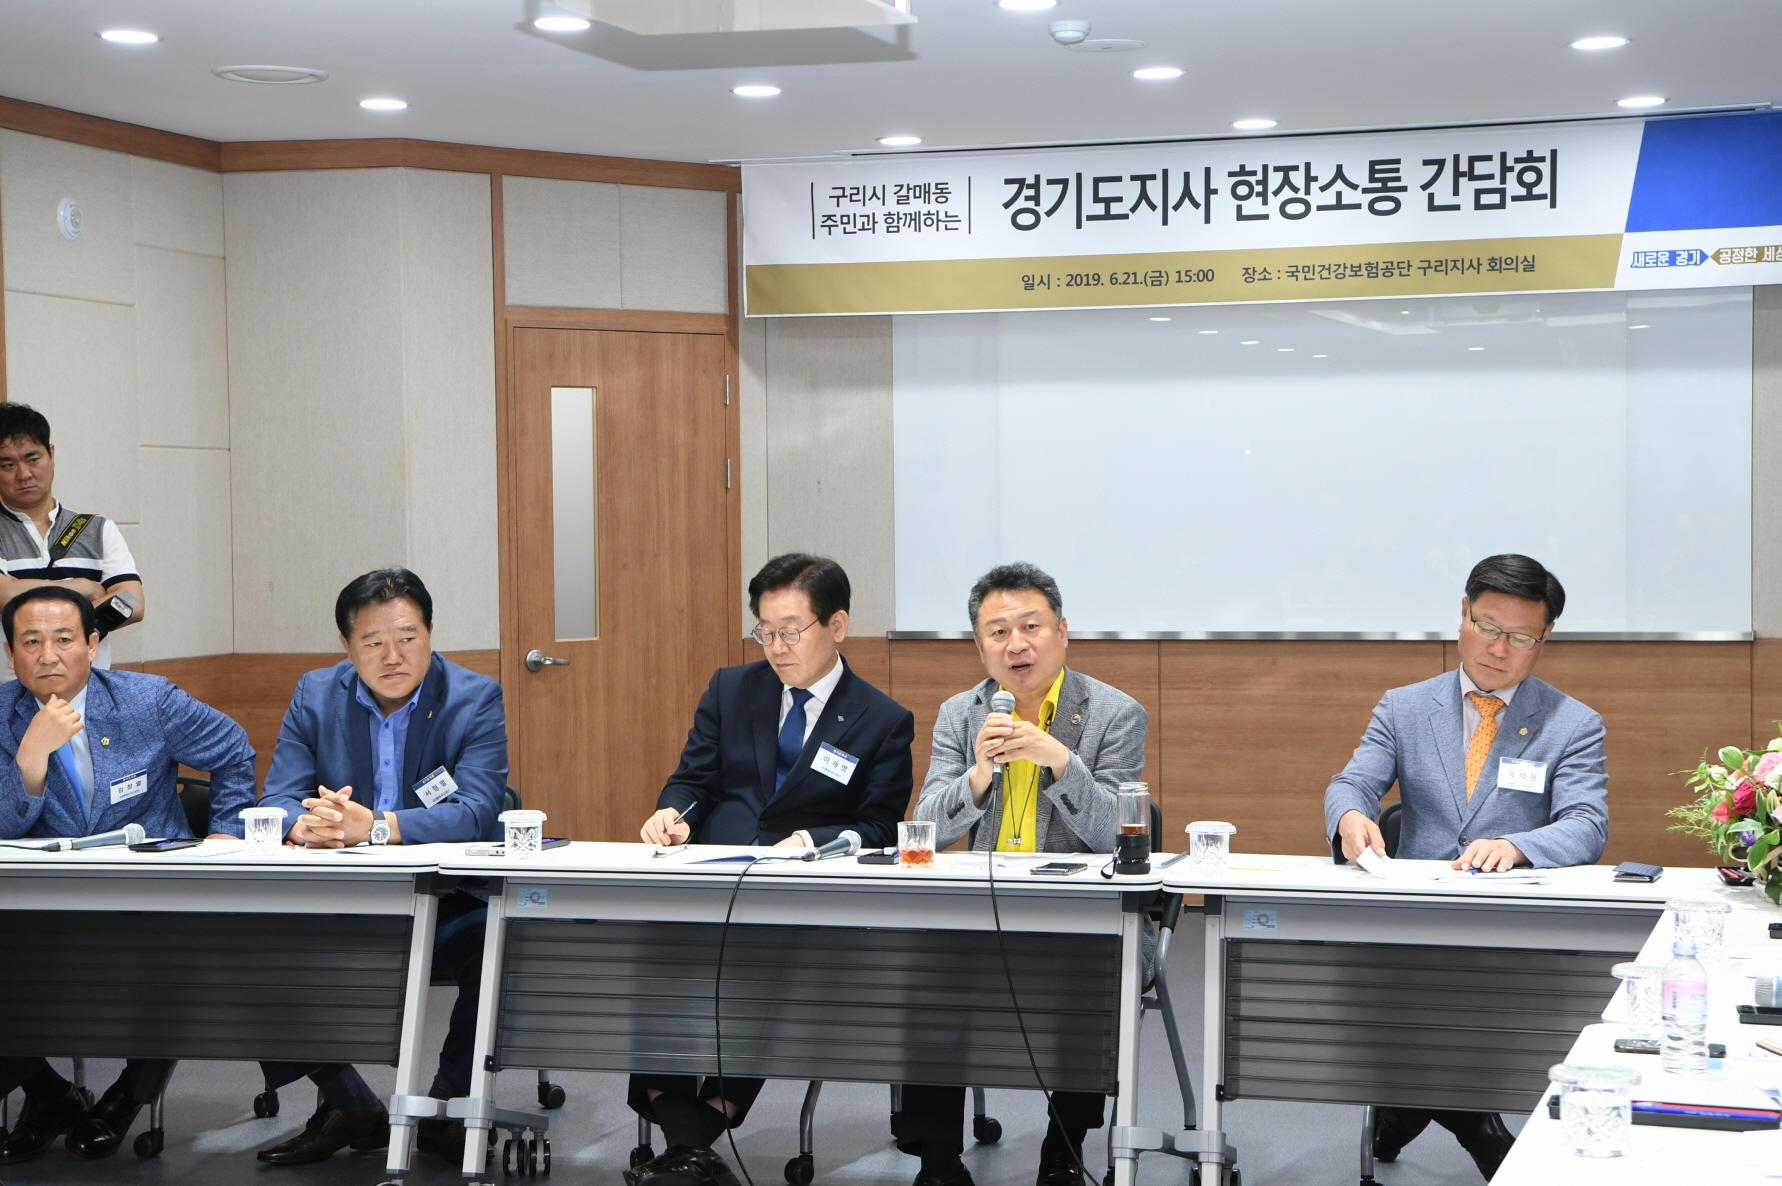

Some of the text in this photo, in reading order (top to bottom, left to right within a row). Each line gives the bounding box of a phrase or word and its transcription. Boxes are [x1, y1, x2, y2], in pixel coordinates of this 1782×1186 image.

[828, 182, 952, 208] 구리시 갈매동
[1001, 148, 1558, 232] 경기도지사 현장소통 간담회
[820, 210, 962, 236] 주민과 함께하는
[1284, 259, 1413, 282] 국민건강보험공단
[1416, 257, 1483, 277] 구리지사
[1486, 254, 1536, 274] 회의실
[1631, 251, 1670, 267] 새로운
[1675, 249, 1701, 266] 경기
[1719, 247, 1758, 264] 공정한
[1065, 272, 1105, 287] 2019.
[1109, 270, 1170, 288] 6.21.(금)
[1175, 268, 1215, 284] 15:00
[60, 528, 77, 547] Nikon
